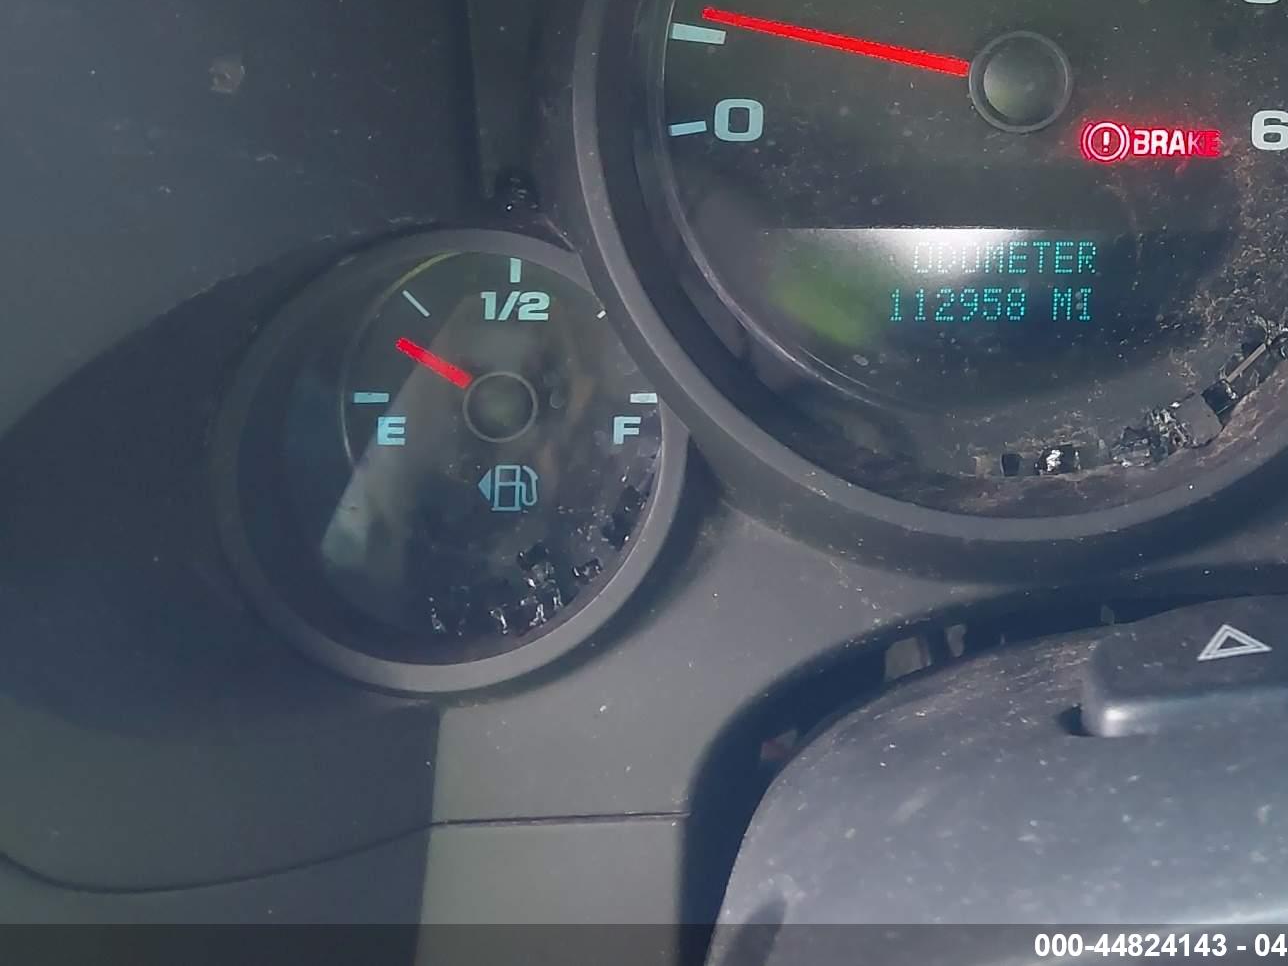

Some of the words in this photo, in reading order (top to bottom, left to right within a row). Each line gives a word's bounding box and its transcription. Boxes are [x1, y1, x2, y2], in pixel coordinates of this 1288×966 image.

[713, 98, 764, 142] 0
[1133, 129, 1221, 156] BRAKE
[914, 241, 1096, 274] ODOMETER
[481, 291, 549, 321] 1/2
[889, 288, 1025, 321] 112958
[1052, 288, 1091, 321] MI
[377, 417, 406, 445] E
[613, 417, 641, 444] F
